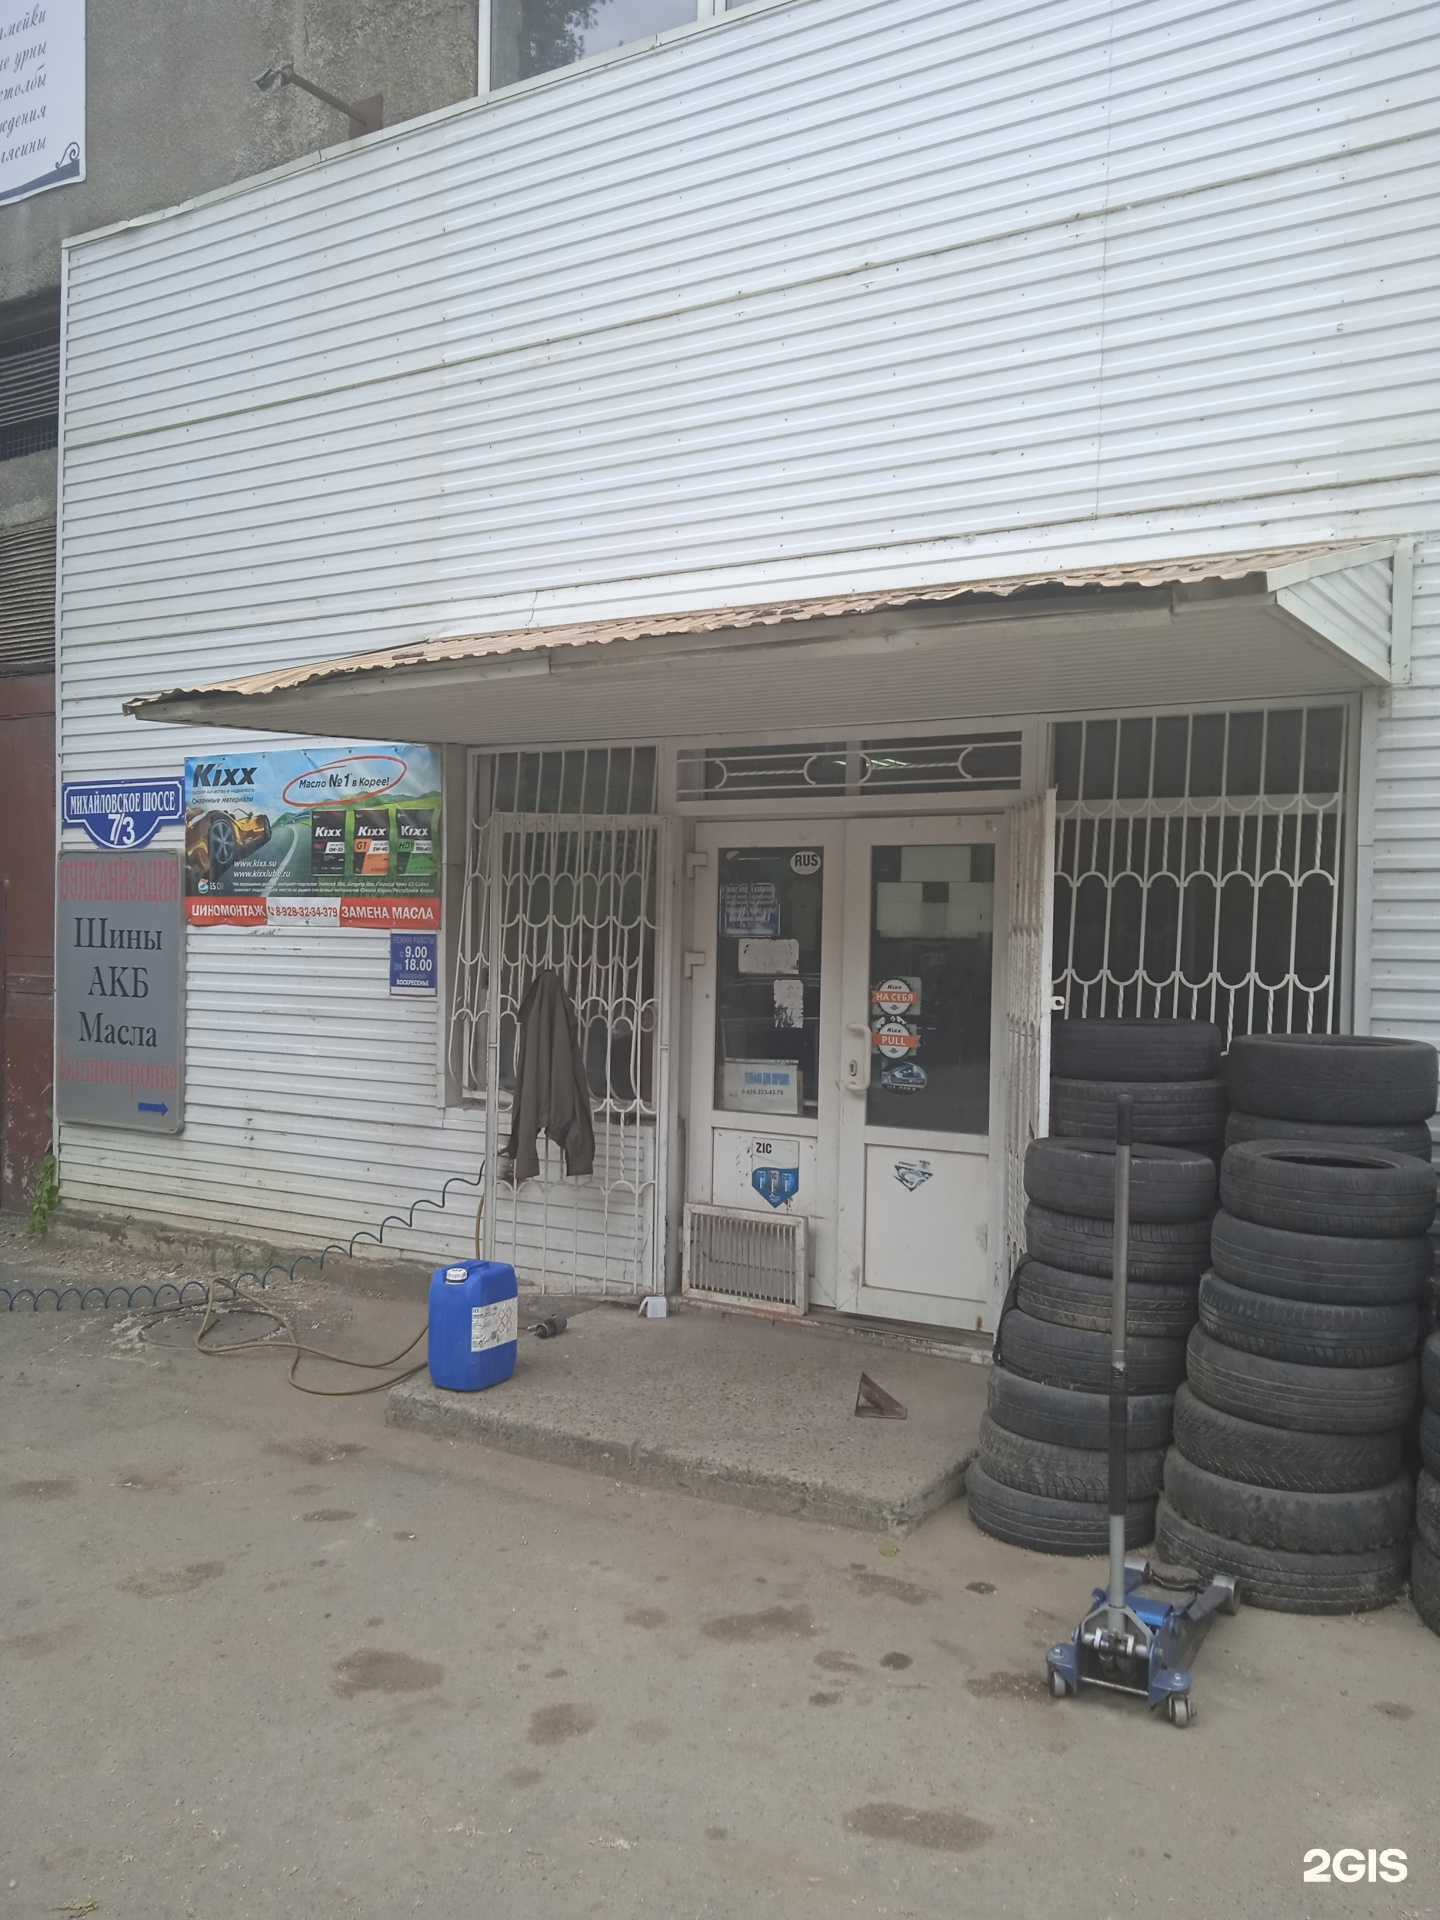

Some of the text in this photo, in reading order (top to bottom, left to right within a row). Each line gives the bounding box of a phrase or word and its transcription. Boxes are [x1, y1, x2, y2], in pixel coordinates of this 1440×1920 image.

[192, 763, 259, 788] Kixx
[299, 779, 327, 789] Масло
[359, 776, 390, 788] Корее!
[70, 791, 176, 815] МИХАЙЛОВСКОЕ ШОССЕ
[108, 813, 136, 846] 7/3
[315, 826, 342, 837] Kixx
[358, 826, 387, 836] Kixx
[401, 825, 428, 836] Kixx
[795, 855, 818, 867] RUS
[341, 904, 434, 920] ЗАМЕНА МАСЛА
[74, 917, 163, 950] Шины
[405, 945, 428, 958] 9.00
[405, 958, 433, 971] 18.00
[88, 966, 150, 998] АКБ
[875, 990, 914, 1002] НА СЕБЯ
[78, 1011, 158, 1048] Масла
[881, 1035, 906, 1046] PULL
[755, 1142, 772, 1154] ZIC
